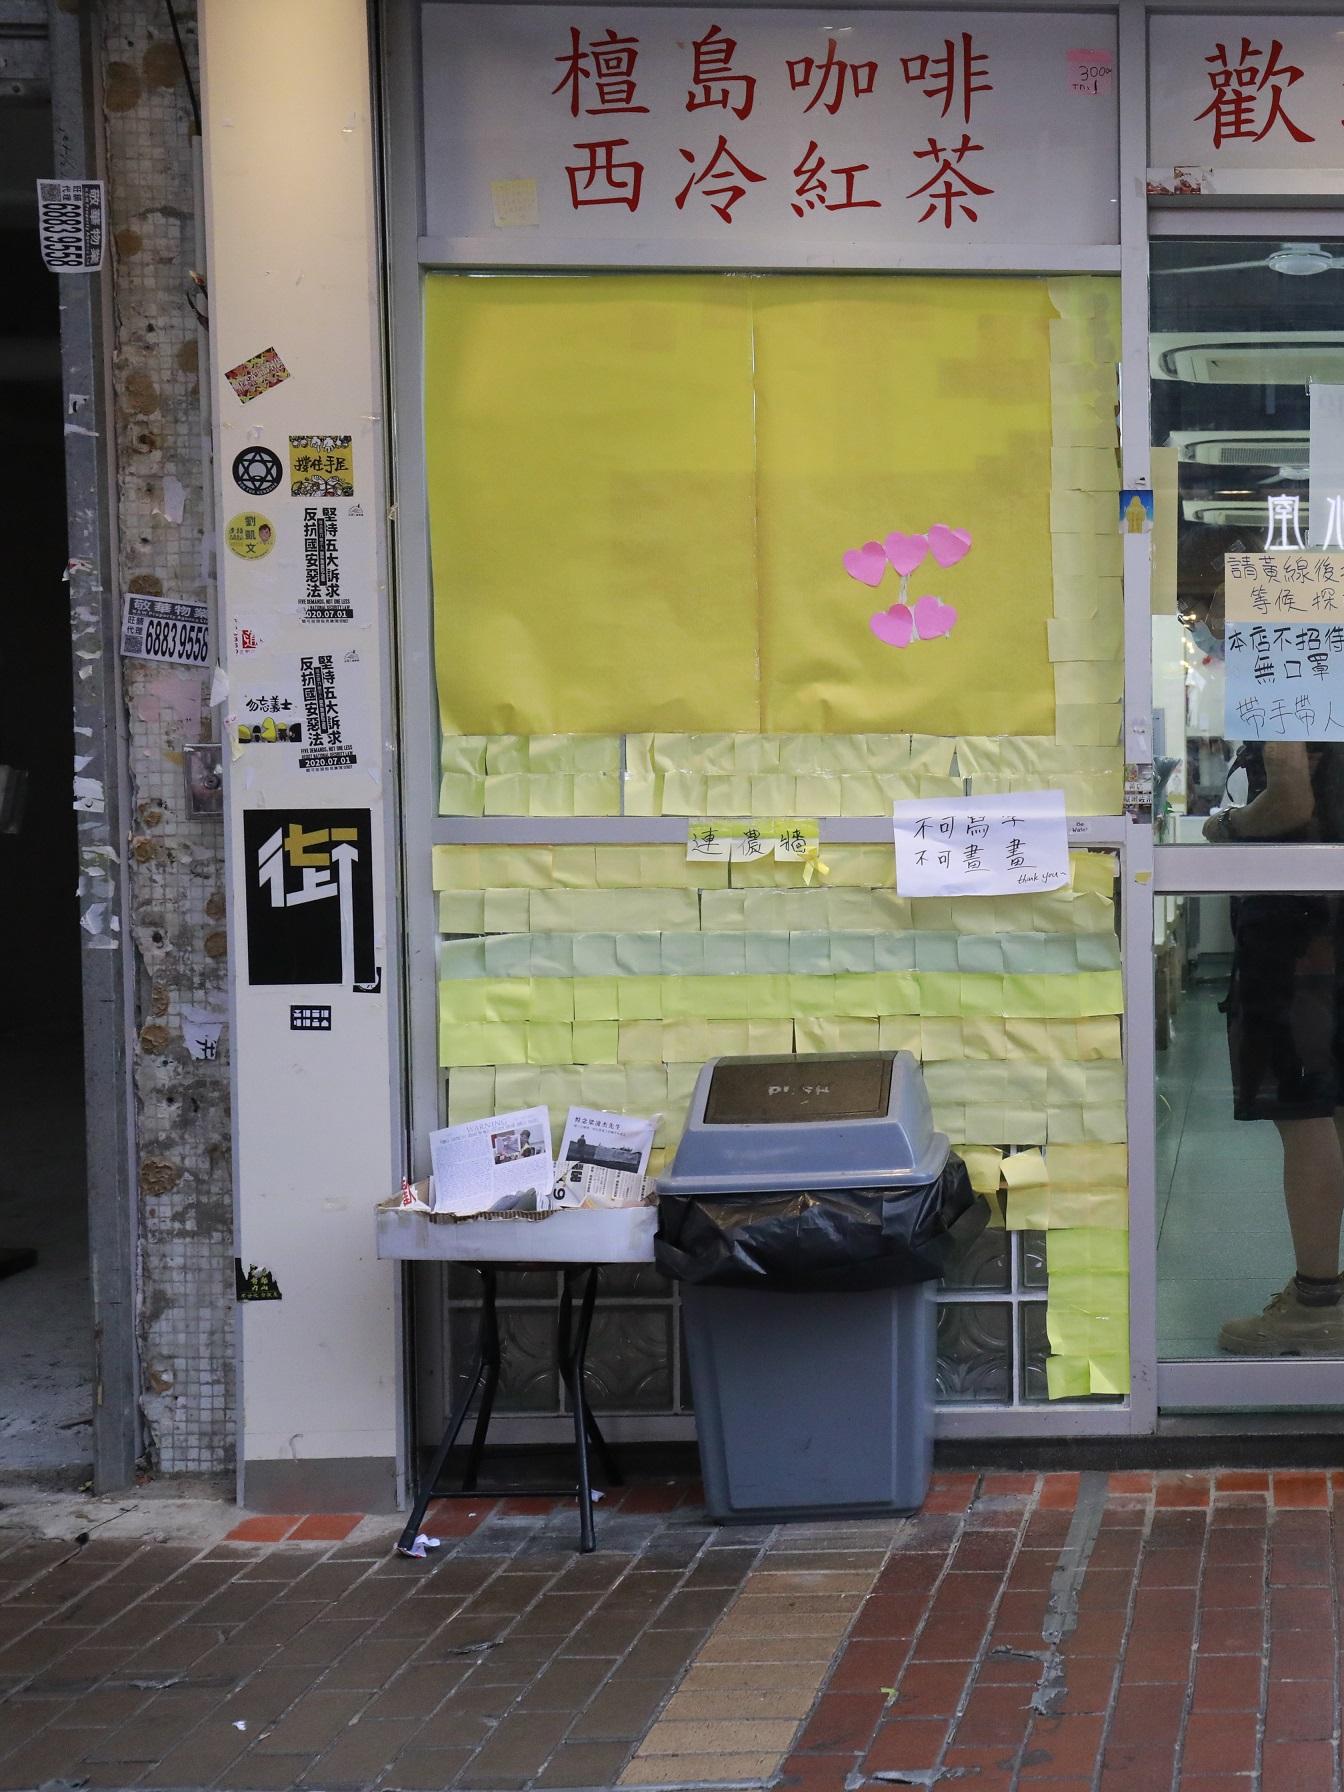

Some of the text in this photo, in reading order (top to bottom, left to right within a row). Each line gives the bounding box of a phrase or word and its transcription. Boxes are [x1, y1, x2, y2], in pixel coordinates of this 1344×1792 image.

[552, 25, 994, 124] 檀島咖啡
[564, 134, 995, 229] 西冷紅茶
[42, 203, 82, 233] 6883
[43, 235, 83, 266] 9558
[303, 507, 322, 598] 反抗國安惡法
[322, 507, 340, 598] 堅持五大訴求
[305, 610, 347, 618] 020.07.01
[145, 619, 178, 657] 6883
[246, 696, 293, 713] 勿忘義士
[300, 656, 324, 747] 反抗國安惡法
[318, 655, 342, 746] 堅持五大訴求
[305, 756, 351, 767] 2020.07.01
[915, 838, 1037, 873] 不可畫畫
